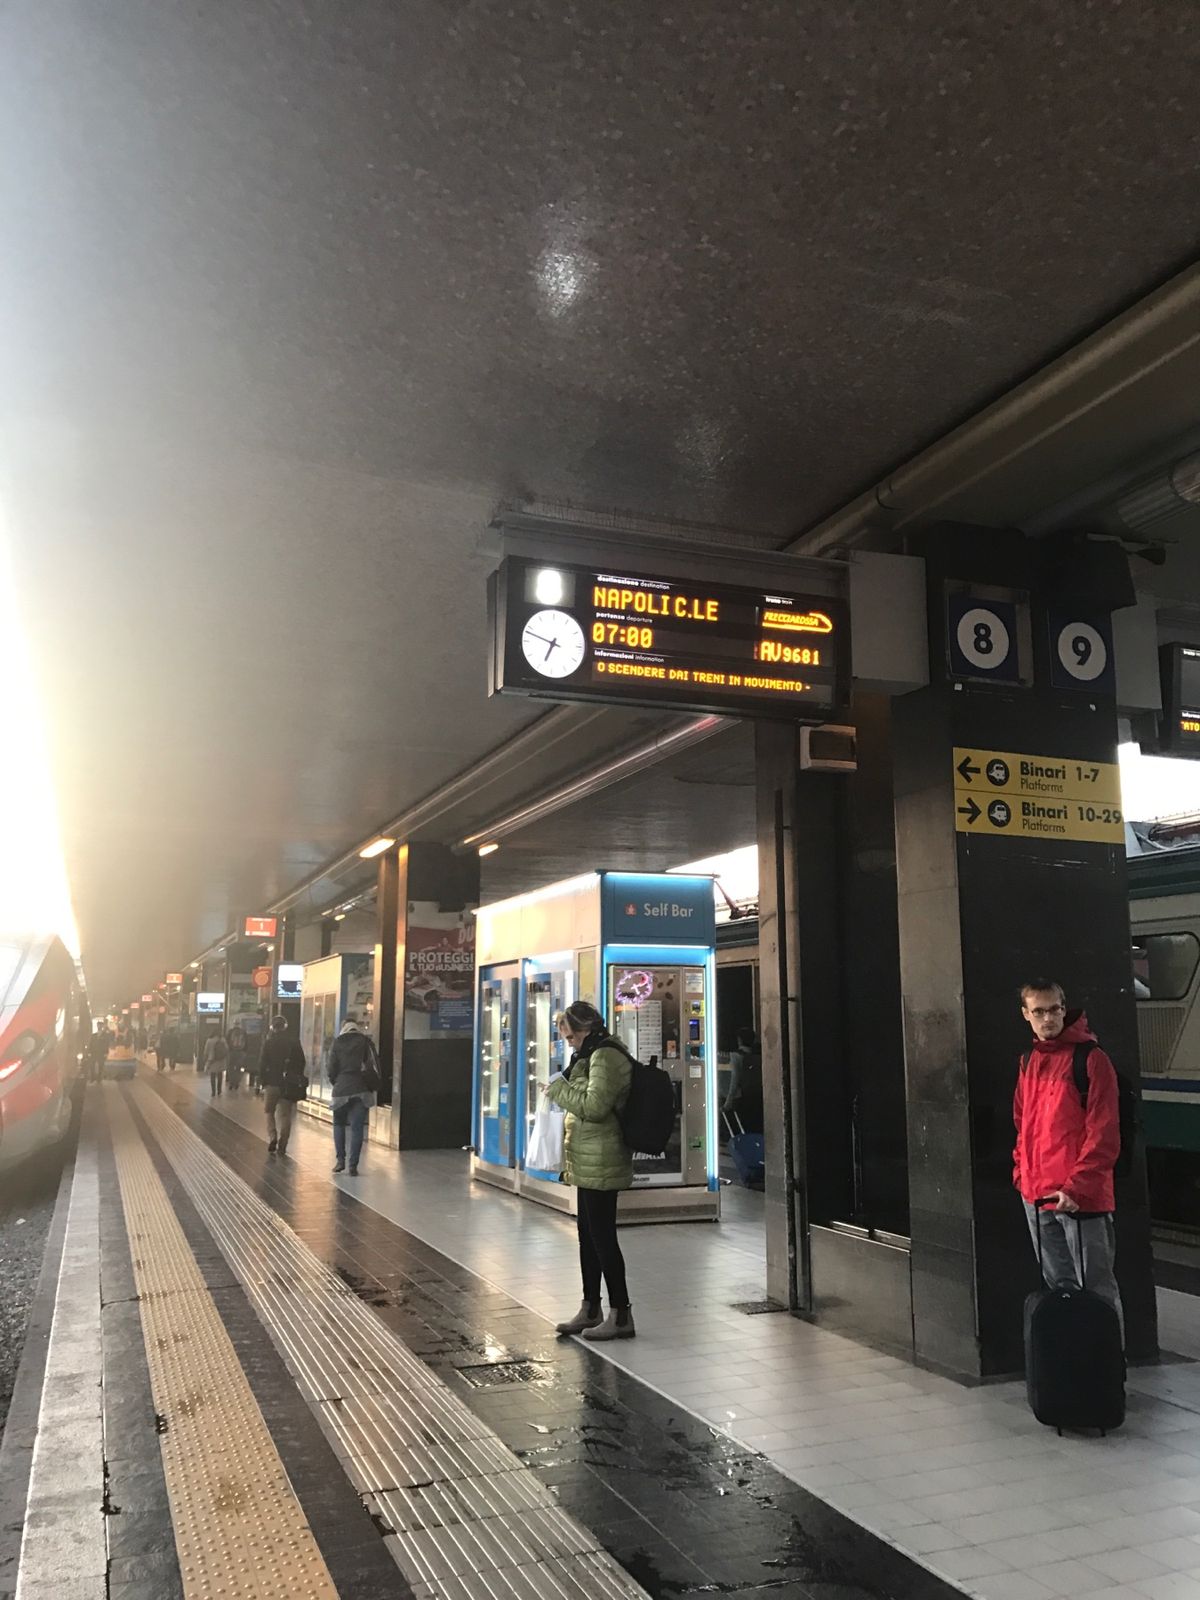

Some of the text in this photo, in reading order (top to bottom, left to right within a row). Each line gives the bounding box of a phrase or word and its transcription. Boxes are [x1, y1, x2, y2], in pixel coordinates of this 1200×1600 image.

[640, 581, 670, 590] destination
[594, 586, 670, 615] NAPOLI
[674, 597, 719, 621] C.LE
[592, 622, 652, 649] 07:00
[973, 622, 994, 655] 8
[594, 649, 664, 663] informazioni information
[1071, 635, 1093, 667] 9
[608, 663, 665, 679] SCENDERE
[669, 669, 689, 680] DAI
[692, 671, 725, 685] TRENI
[728, 675, 741, 685] IN
[744, 677, 802, 692] MOVIMENTO
[1020, 761, 1100, 783] Binari 1-7
[1020, 778, 1064, 793] Platforms
[1021, 802, 1121, 824] Binari 10-29
[1022, 818, 1066, 833] Platforms
[643, 902, 694, 917] Self Bar
[409, 951, 474, 964] PROTEGGI
